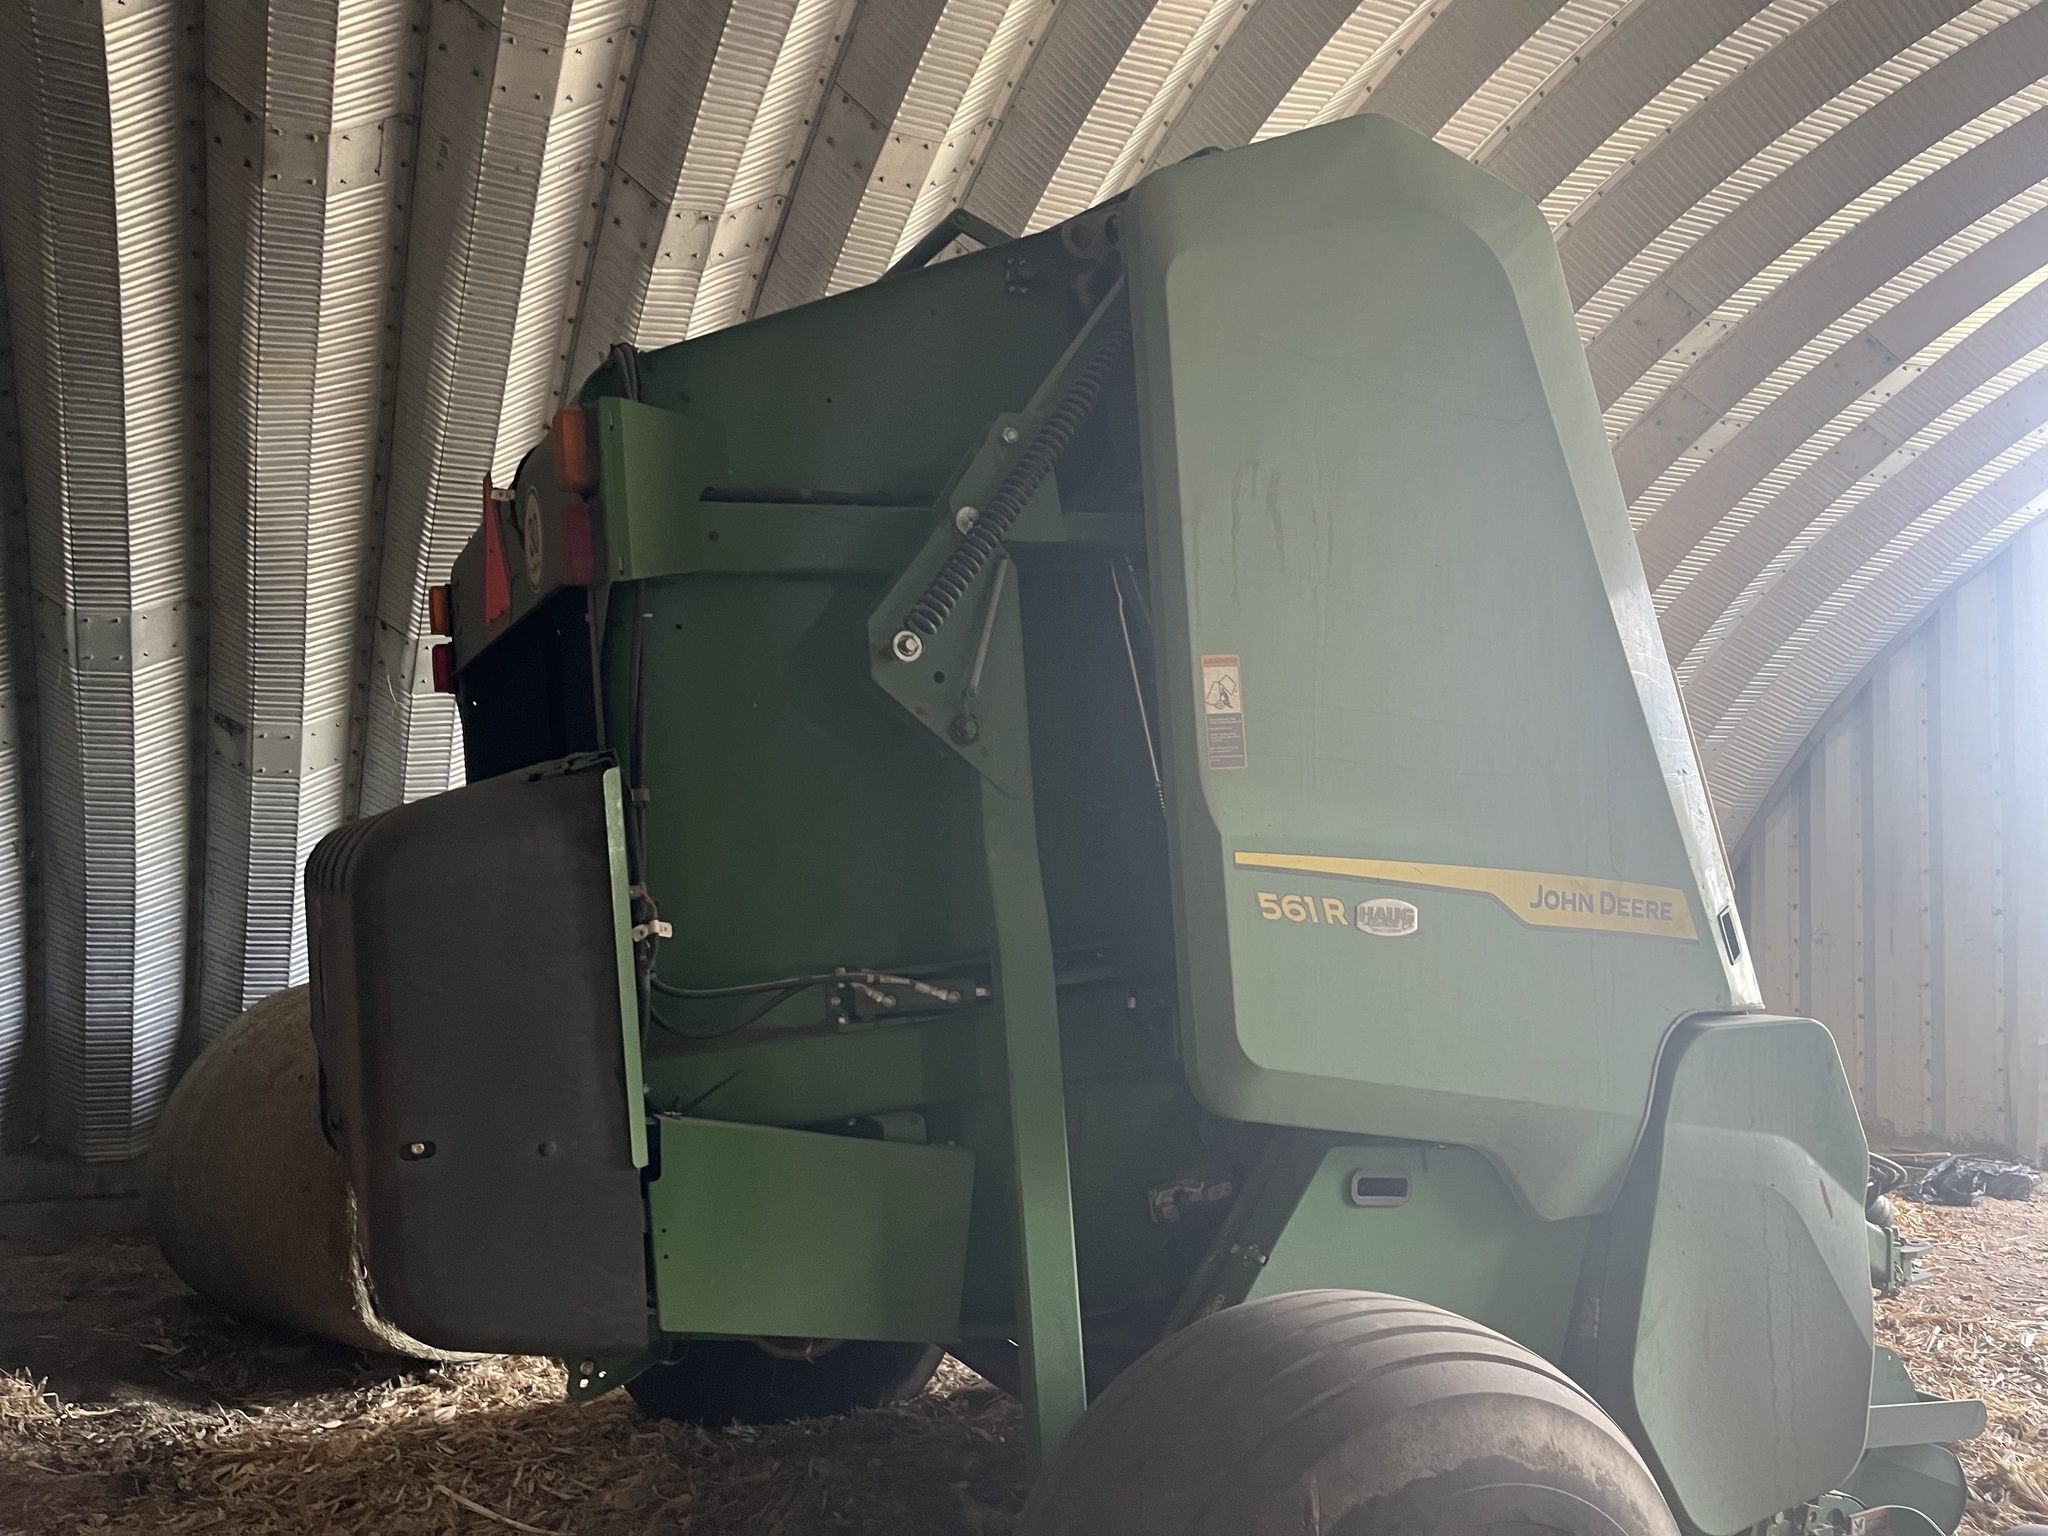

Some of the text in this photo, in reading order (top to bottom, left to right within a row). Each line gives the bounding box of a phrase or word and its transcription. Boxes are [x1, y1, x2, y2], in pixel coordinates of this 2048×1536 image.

[1257, 891, 1349, 926] 561 R
[1359, 905, 1415, 928] HAUG
[1529, 884, 1673, 921] JOHN DEERE
